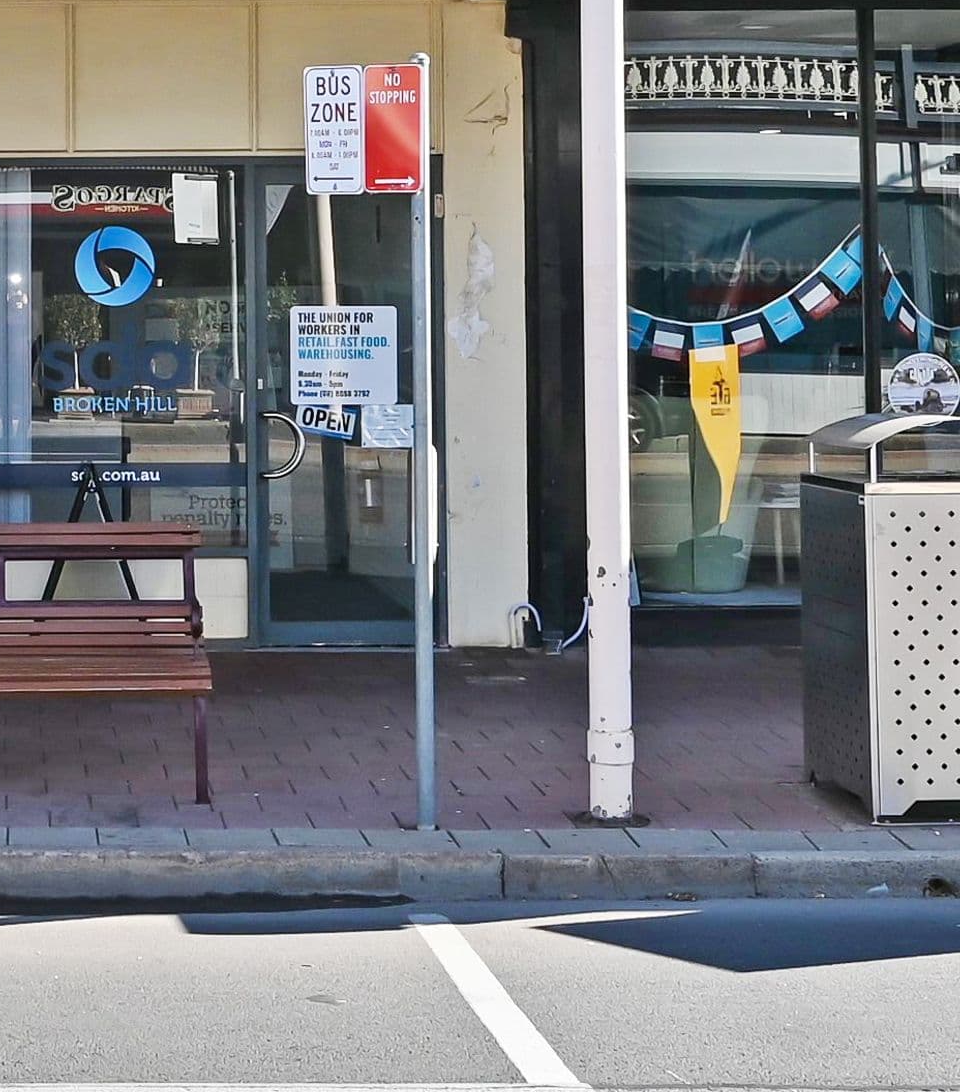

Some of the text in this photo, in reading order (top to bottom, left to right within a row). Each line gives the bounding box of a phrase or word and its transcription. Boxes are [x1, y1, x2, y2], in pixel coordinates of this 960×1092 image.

[316, 76, 351, 95] BUS
[384, 73, 400, 86] NO
[369, 90, 416, 104] STOPPING
[311, 103, 357, 122] ZONE
[298, 312, 374, 323] THE UNION FOR
[298, 324, 360, 335] WORKERS IN
[298, 348, 374, 359] WAREHOUSING.
[53, 396, 178, 412] BROKEN HILL
[302, 407, 351, 433] OPEN
[71, 468, 160, 482] s.com.au
[189, 494, 248, 509] Protec
